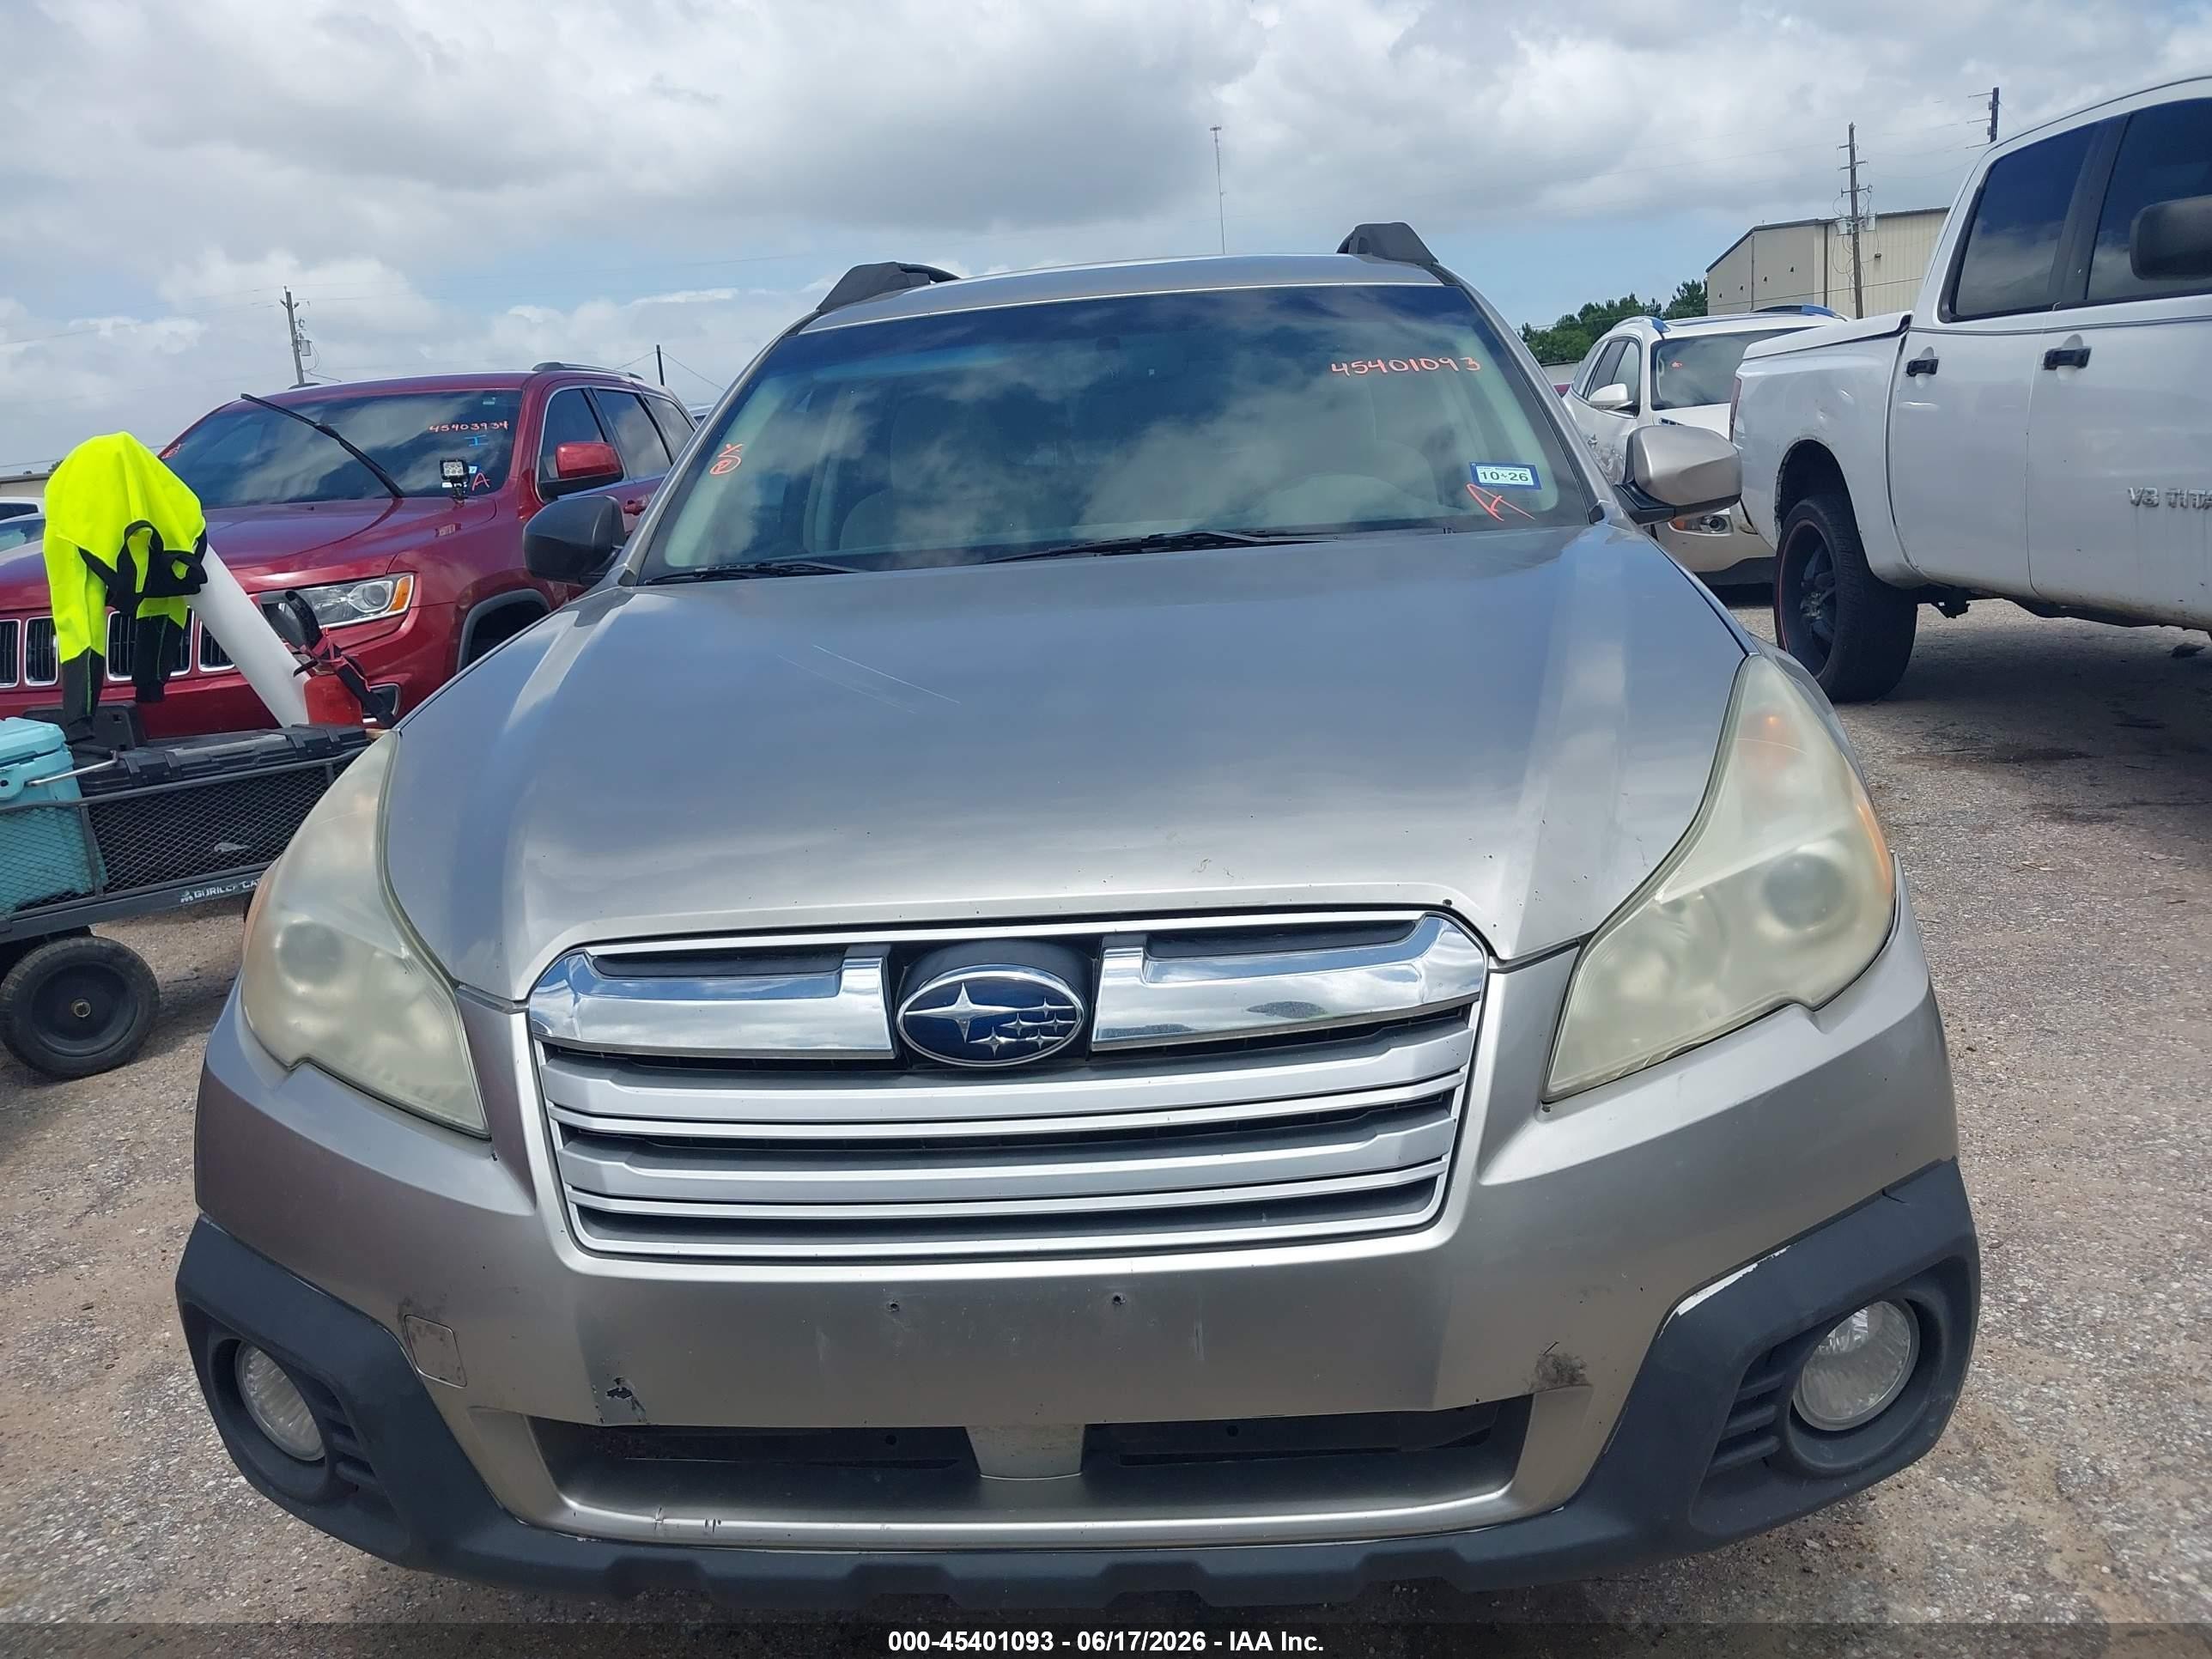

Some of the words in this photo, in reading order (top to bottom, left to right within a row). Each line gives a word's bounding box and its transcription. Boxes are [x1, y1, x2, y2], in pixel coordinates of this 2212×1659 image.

[1331, 356, 1481, 377] 45401093
[429, 420, 508, 432] 45403934
[471, 472, 490, 491] A
[1480, 471, 1500, 481] 10
[1508, 472, 1529, 482] 26
